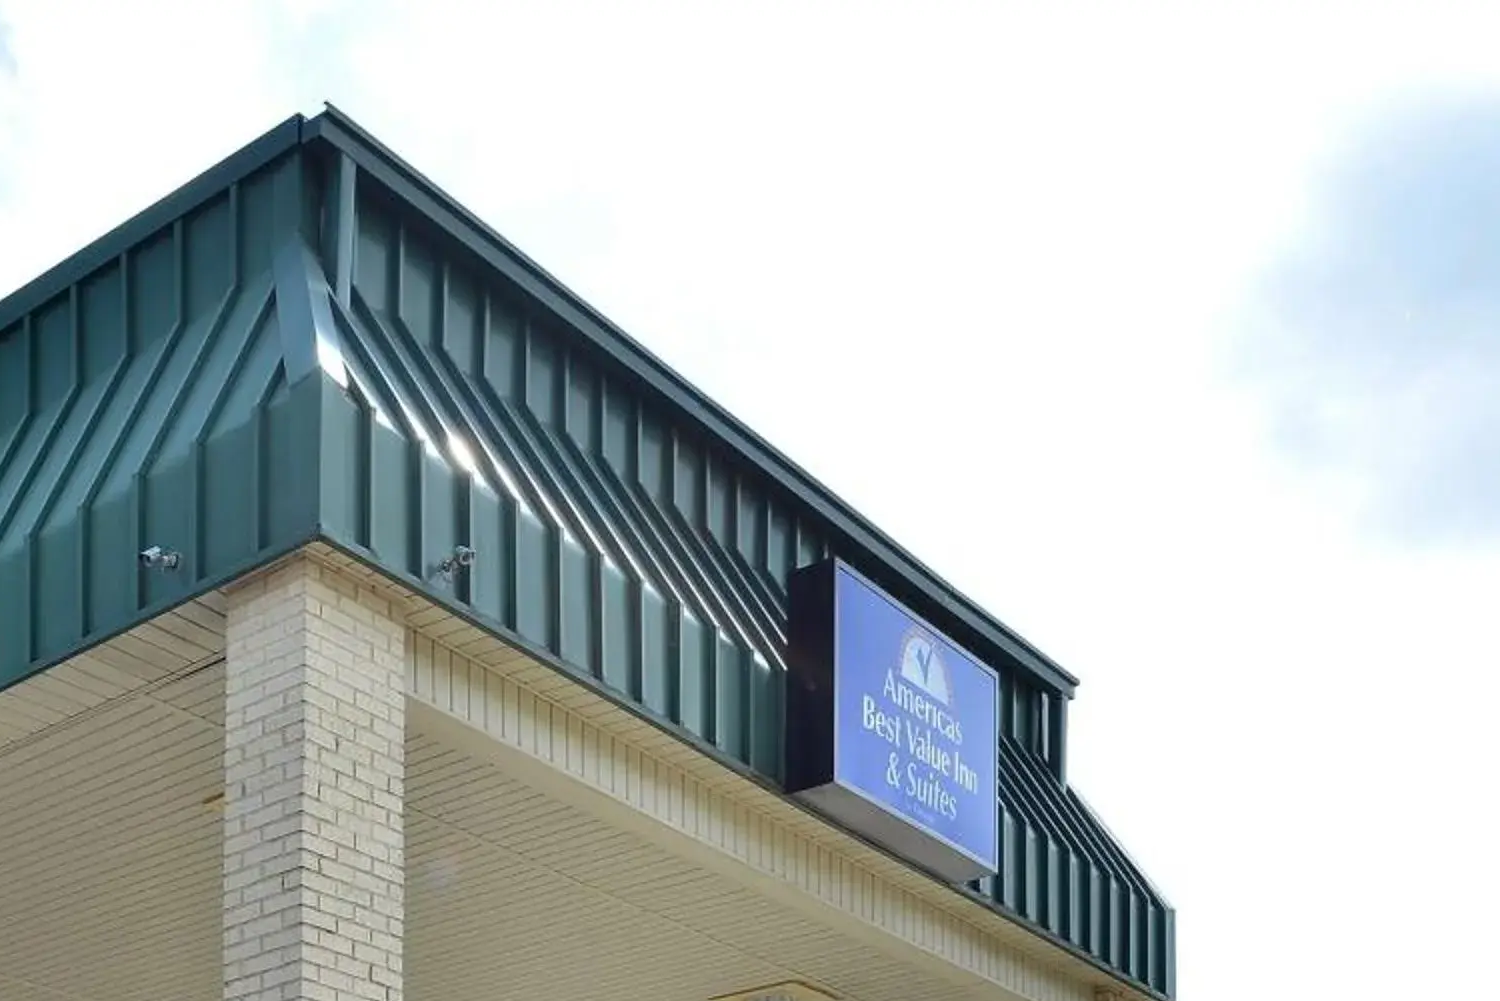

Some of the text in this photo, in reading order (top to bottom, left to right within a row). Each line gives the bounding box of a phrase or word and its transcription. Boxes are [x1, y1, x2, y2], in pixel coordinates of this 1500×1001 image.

[863, 693, 979, 795] Best Value Inn
[883, 668, 963, 745] Americas
[886, 751, 901, 790] &
[905, 762, 958, 820] Suites
